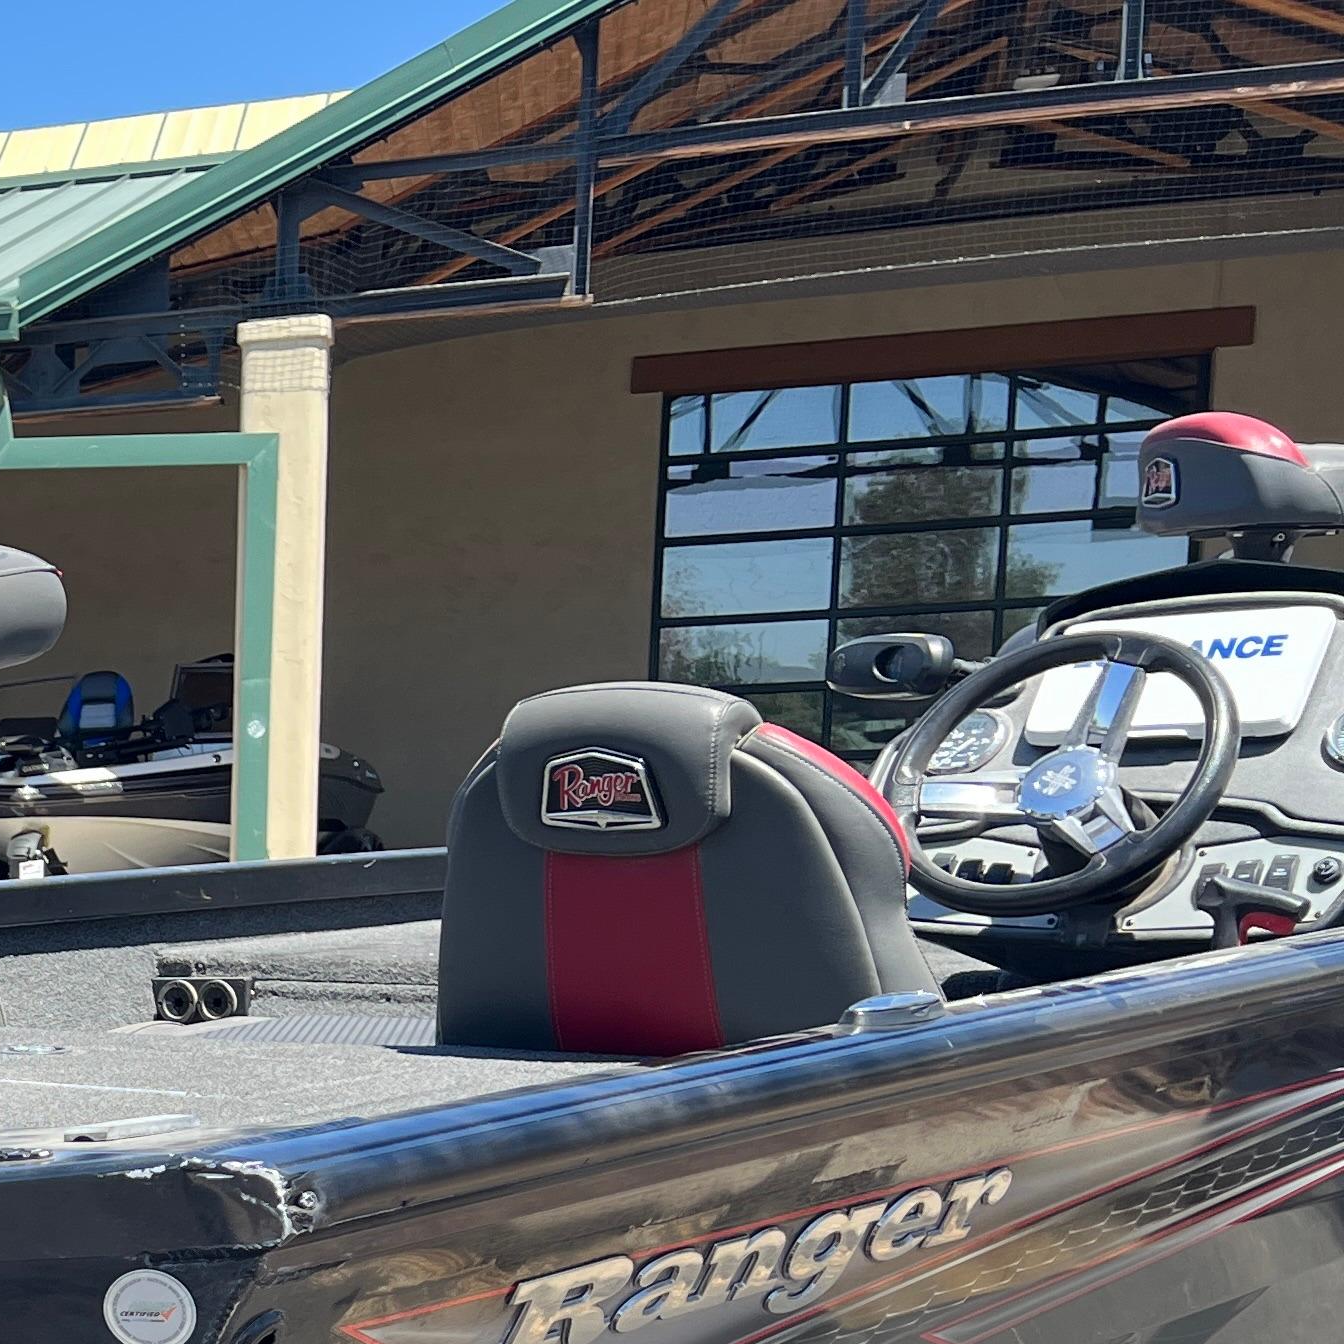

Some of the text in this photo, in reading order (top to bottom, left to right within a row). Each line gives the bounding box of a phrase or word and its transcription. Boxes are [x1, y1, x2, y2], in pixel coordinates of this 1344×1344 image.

[1189, 634, 1289, 660] ANCE
[553, 764, 641, 810] Ranger
[119, 1310, 161, 1318] CERTIFIED
